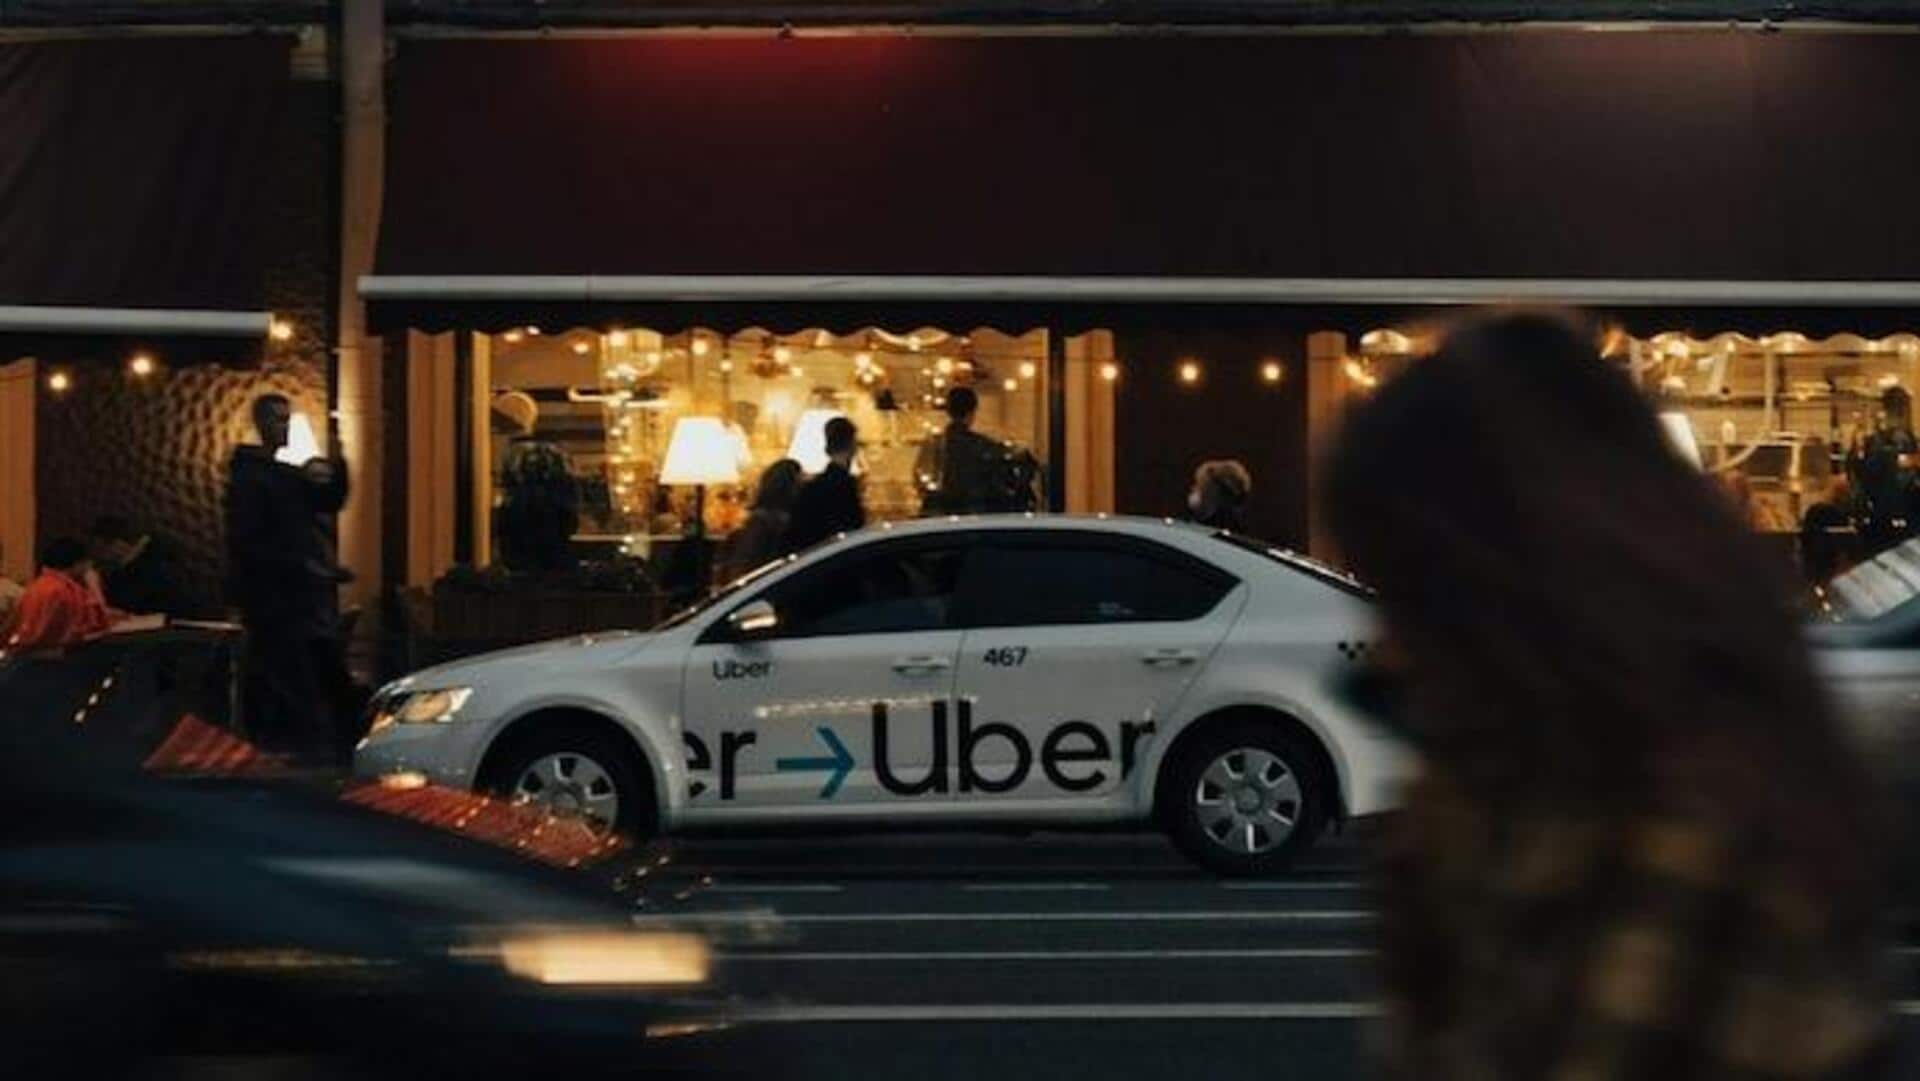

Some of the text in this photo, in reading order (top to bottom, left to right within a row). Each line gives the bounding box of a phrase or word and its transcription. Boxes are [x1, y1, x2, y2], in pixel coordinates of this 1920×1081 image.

[983, 646, 1028, 667] 467
[712, 660, 773, 681] Uber
[872, 699, 1157, 795] Uber
